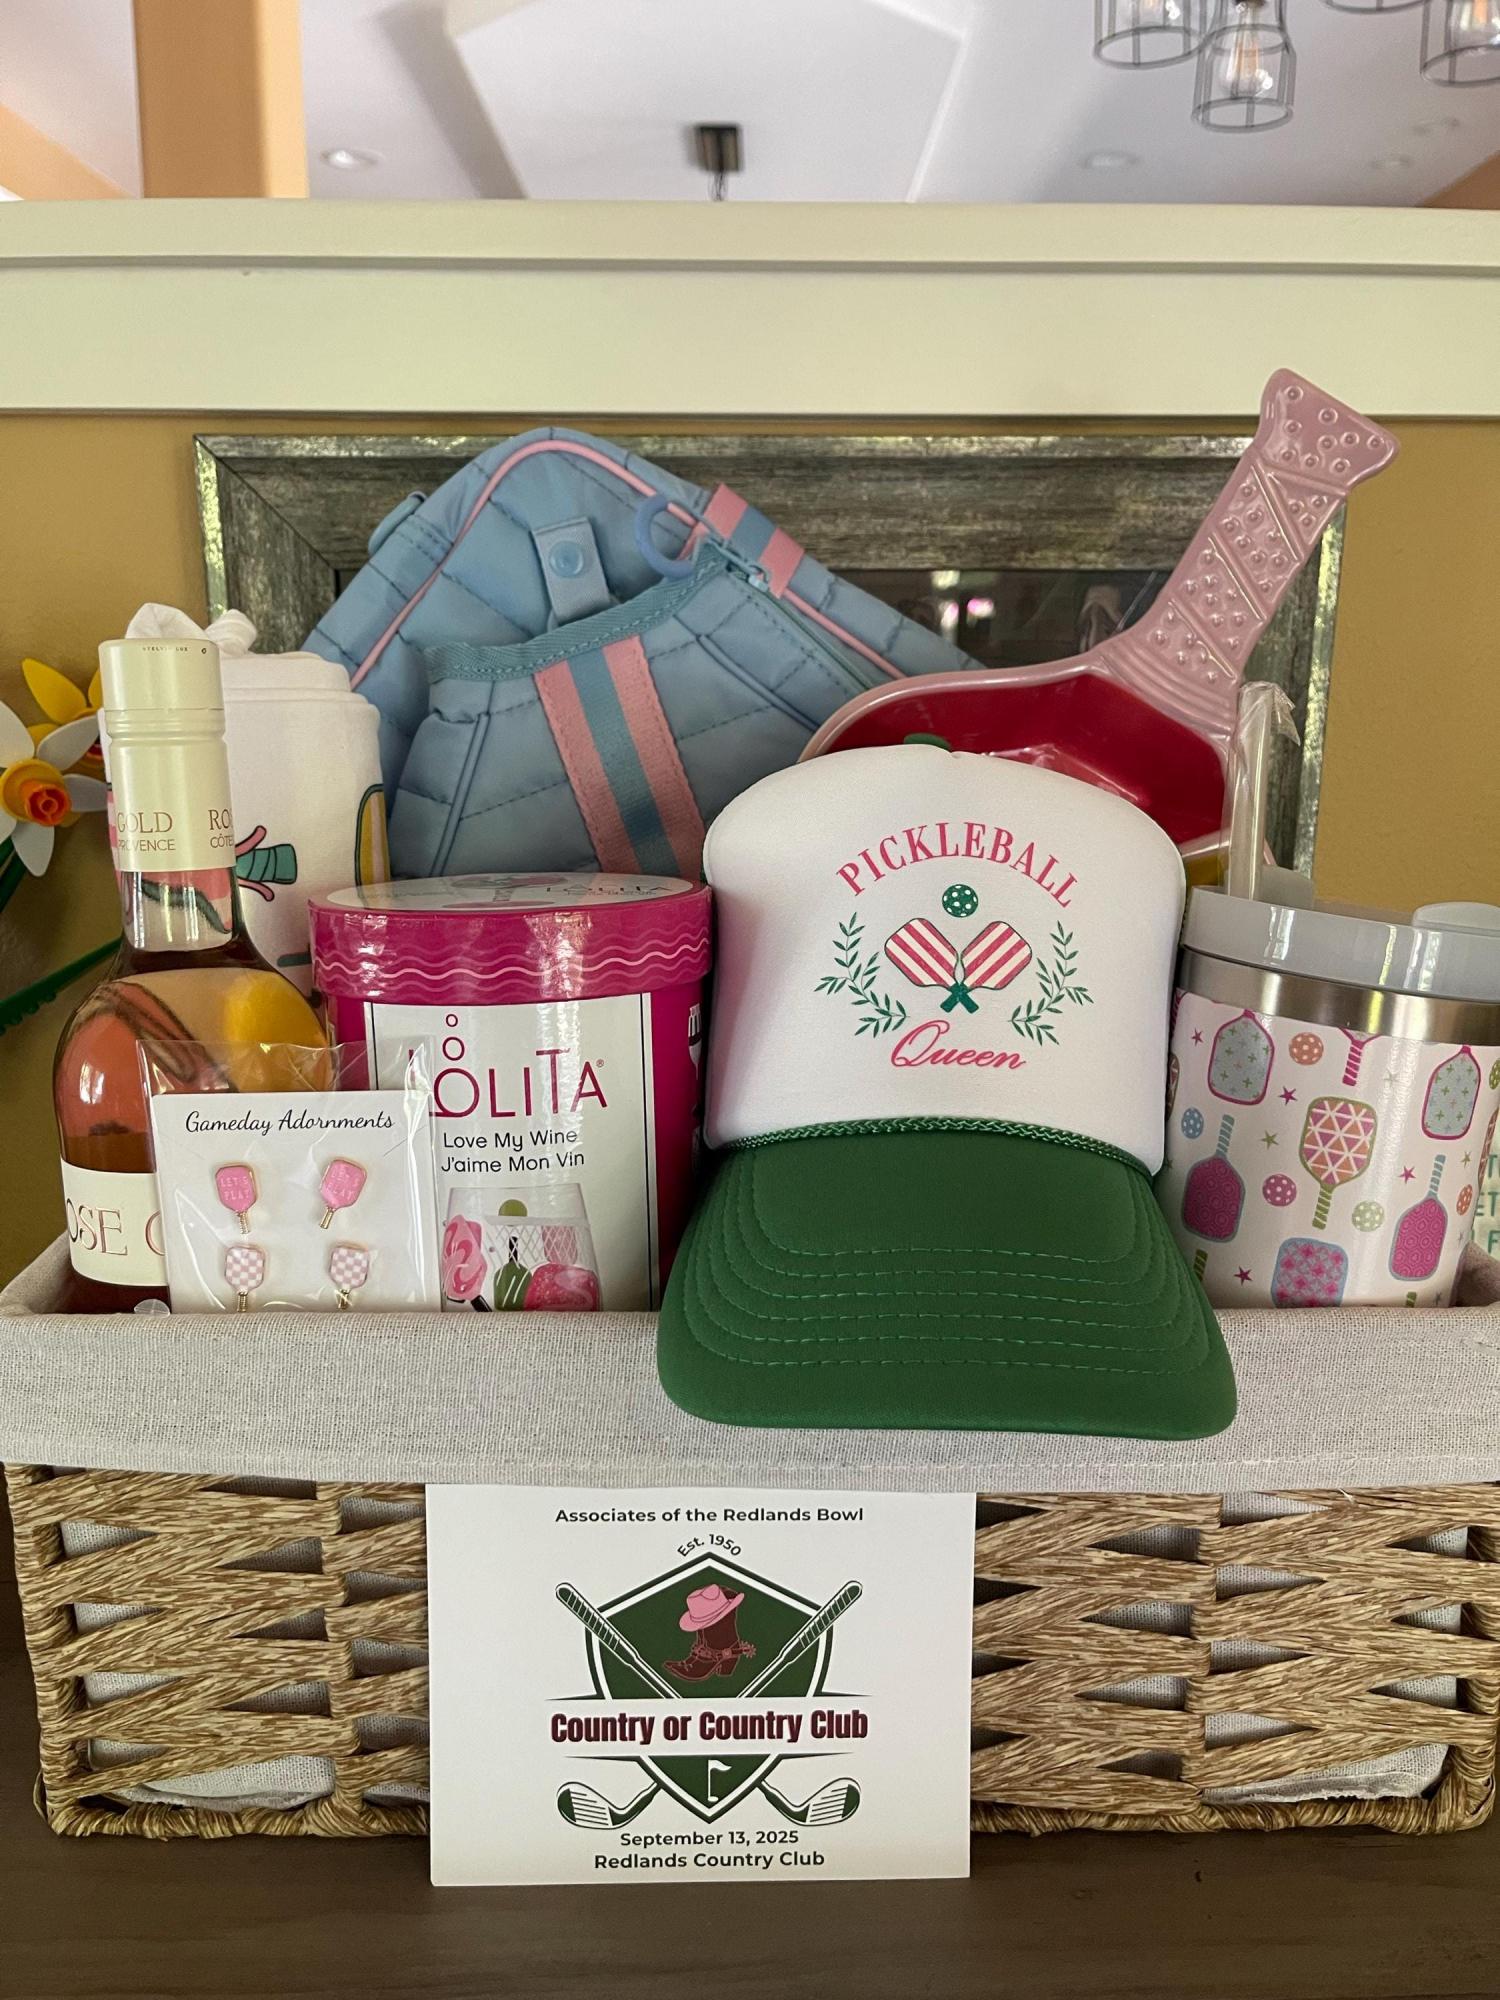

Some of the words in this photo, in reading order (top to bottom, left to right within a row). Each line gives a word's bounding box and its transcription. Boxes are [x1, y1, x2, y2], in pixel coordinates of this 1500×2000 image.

[117, 811, 173, 834] GOLD
[118, 838, 176, 852] PROVENCE
[835, 821, 1078, 908] PICKLEBALL
[890, 1019, 1027, 1070] Queen
[185, 1109, 273, 1136] Gameday
[278, 1108, 395, 1131] Adornments
[443, 1131, 487, 1149] Love
[494, 1132, 523, 1152] My
[529, 1129, 578, 1146] Wine
[441, 1156, 502, 1173] J'aime
[509, 1156, 550, 1173] Mon
[556, 1151, 585, 1168] Vin
[554, 1508, 656, 1522] Associates
[661, 1508, 681, 1522] of
[686, 1508, 717, 1522] the
[723, 1507, 811, 1522] Redlands
[816, 1507, 864, 1521] Bowl
[677, 1535, 705, 1558] Est.
[708, 1533, 742, 1557] 1950
[550, 1713, 655, 1745] Country
[663, 1715, 692, 1742] or
[700, 1711, 803, 1743] Country
[811, 1709, 868, 1739] Club
[620, 1832, 723, 1849] September
[728, 1831, 751, 1847] 13,
[755, 1830, 799, 1844] 2025
[594, 1853, 687, 1869] Redlands
[693, 1853, 774, 1870] Country
[779, 1851, 825, 1866] Club
